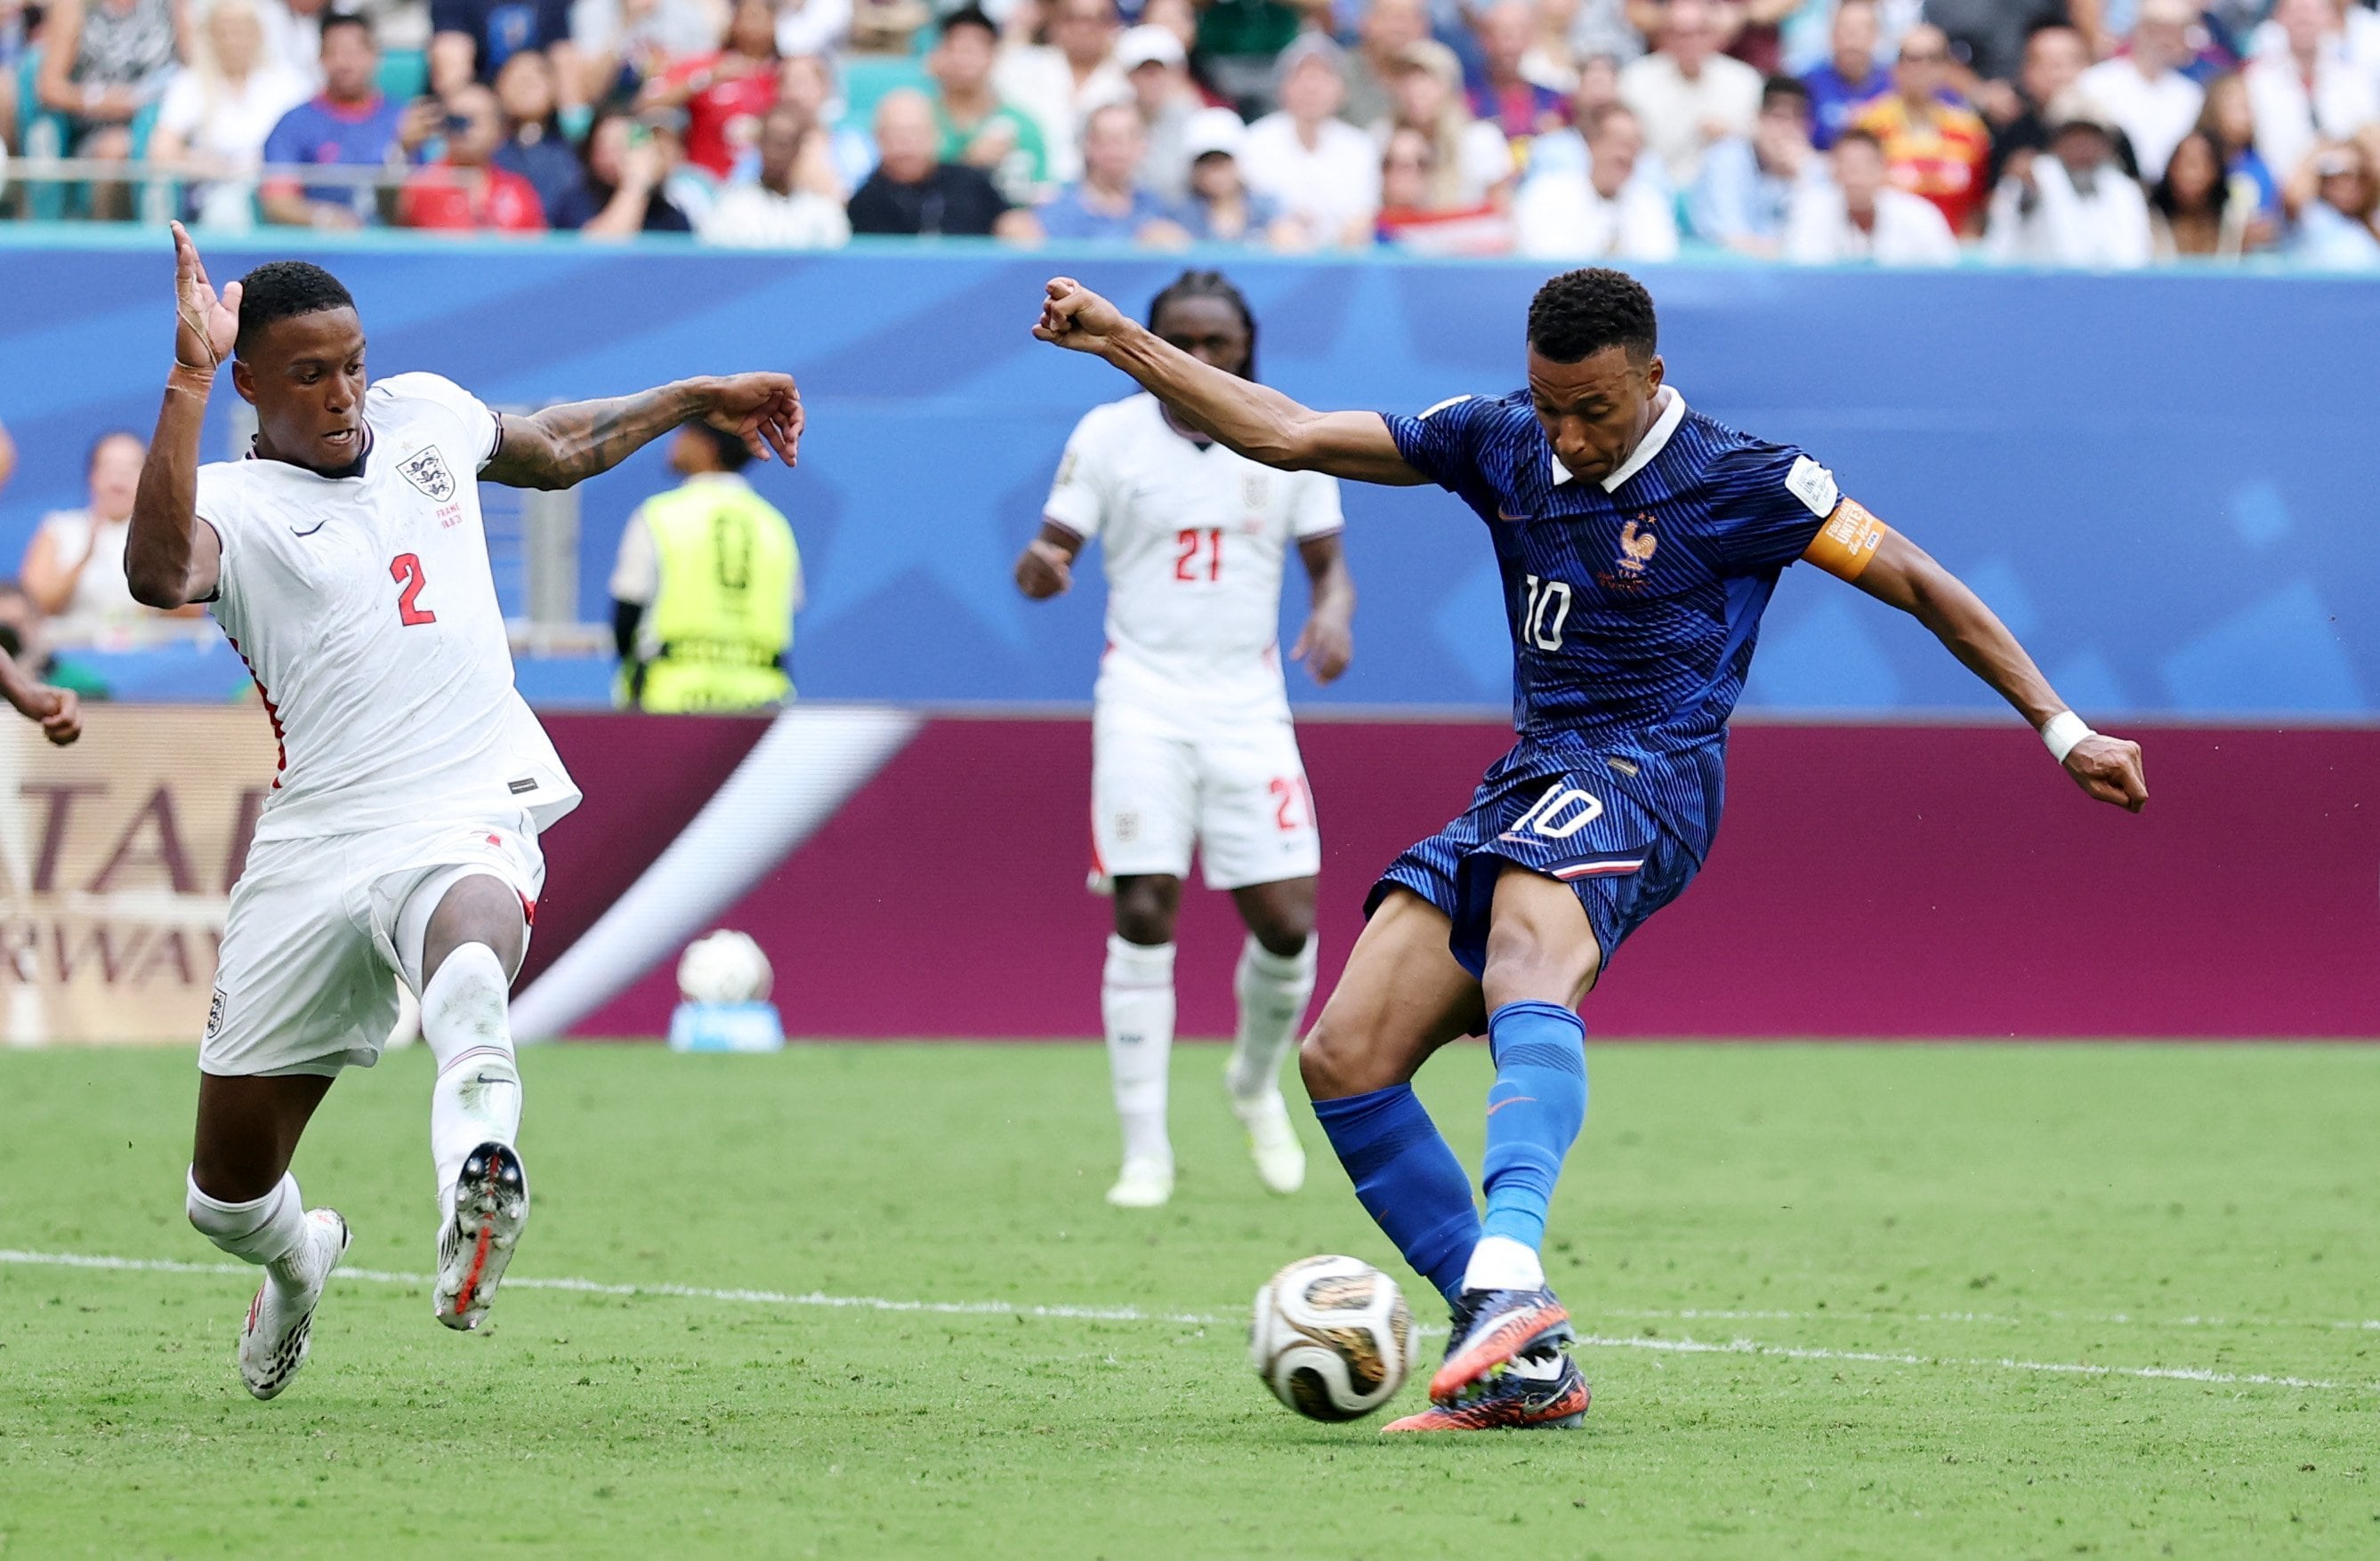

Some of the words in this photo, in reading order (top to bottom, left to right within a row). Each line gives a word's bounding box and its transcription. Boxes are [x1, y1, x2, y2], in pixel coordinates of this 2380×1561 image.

[1834, 503, 1867, 544] UNITES
[1176, 527, 1221, 583] 21
[390, 552, 437, 626] 2
[1524, 574, 1571, 651] 10
[1512, 784, 1603, 838] 10
